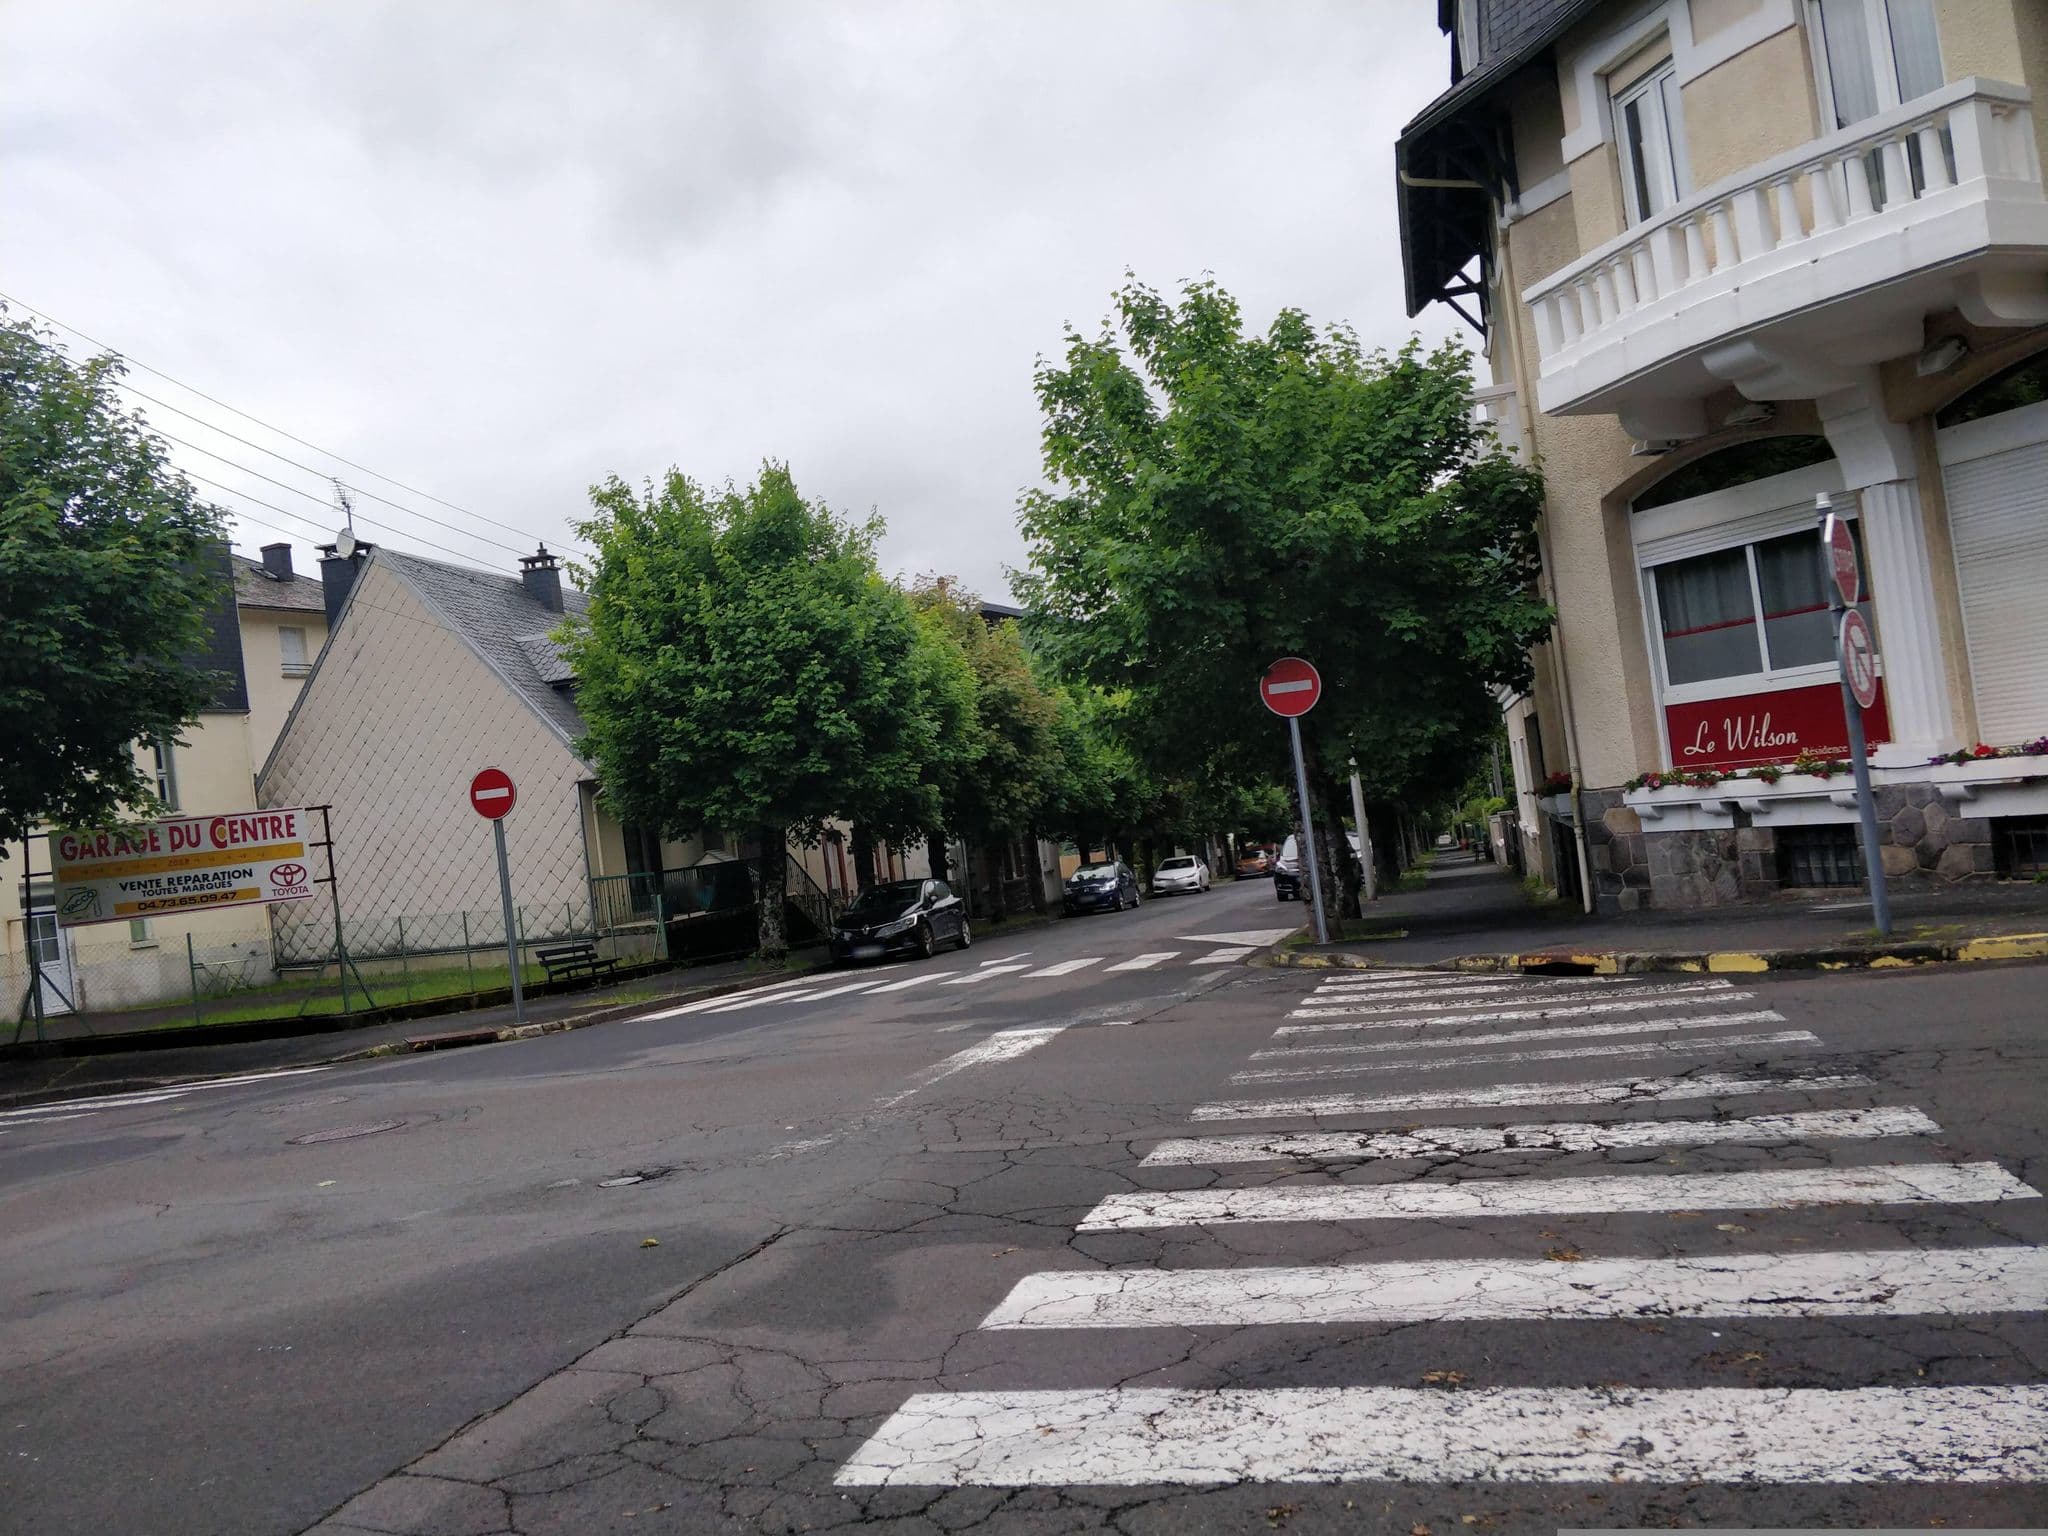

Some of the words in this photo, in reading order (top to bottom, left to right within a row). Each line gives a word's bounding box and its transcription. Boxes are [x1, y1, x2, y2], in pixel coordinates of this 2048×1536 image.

[1683, 720, 1715, 755] Le
[1723, 712, 1798, 751] Wilson
[168, 823, 201, 850] DU
[209, 814, 297, 849] CENTRE
[119, 878, 162, 892] VENTE
[167, 868, 253, 887] REPARATION
[142, 886, 178, 898] TOUTES
[182, 880, 232, 893] MARQUES
[271, 885, 309, 897] TOYOTA
